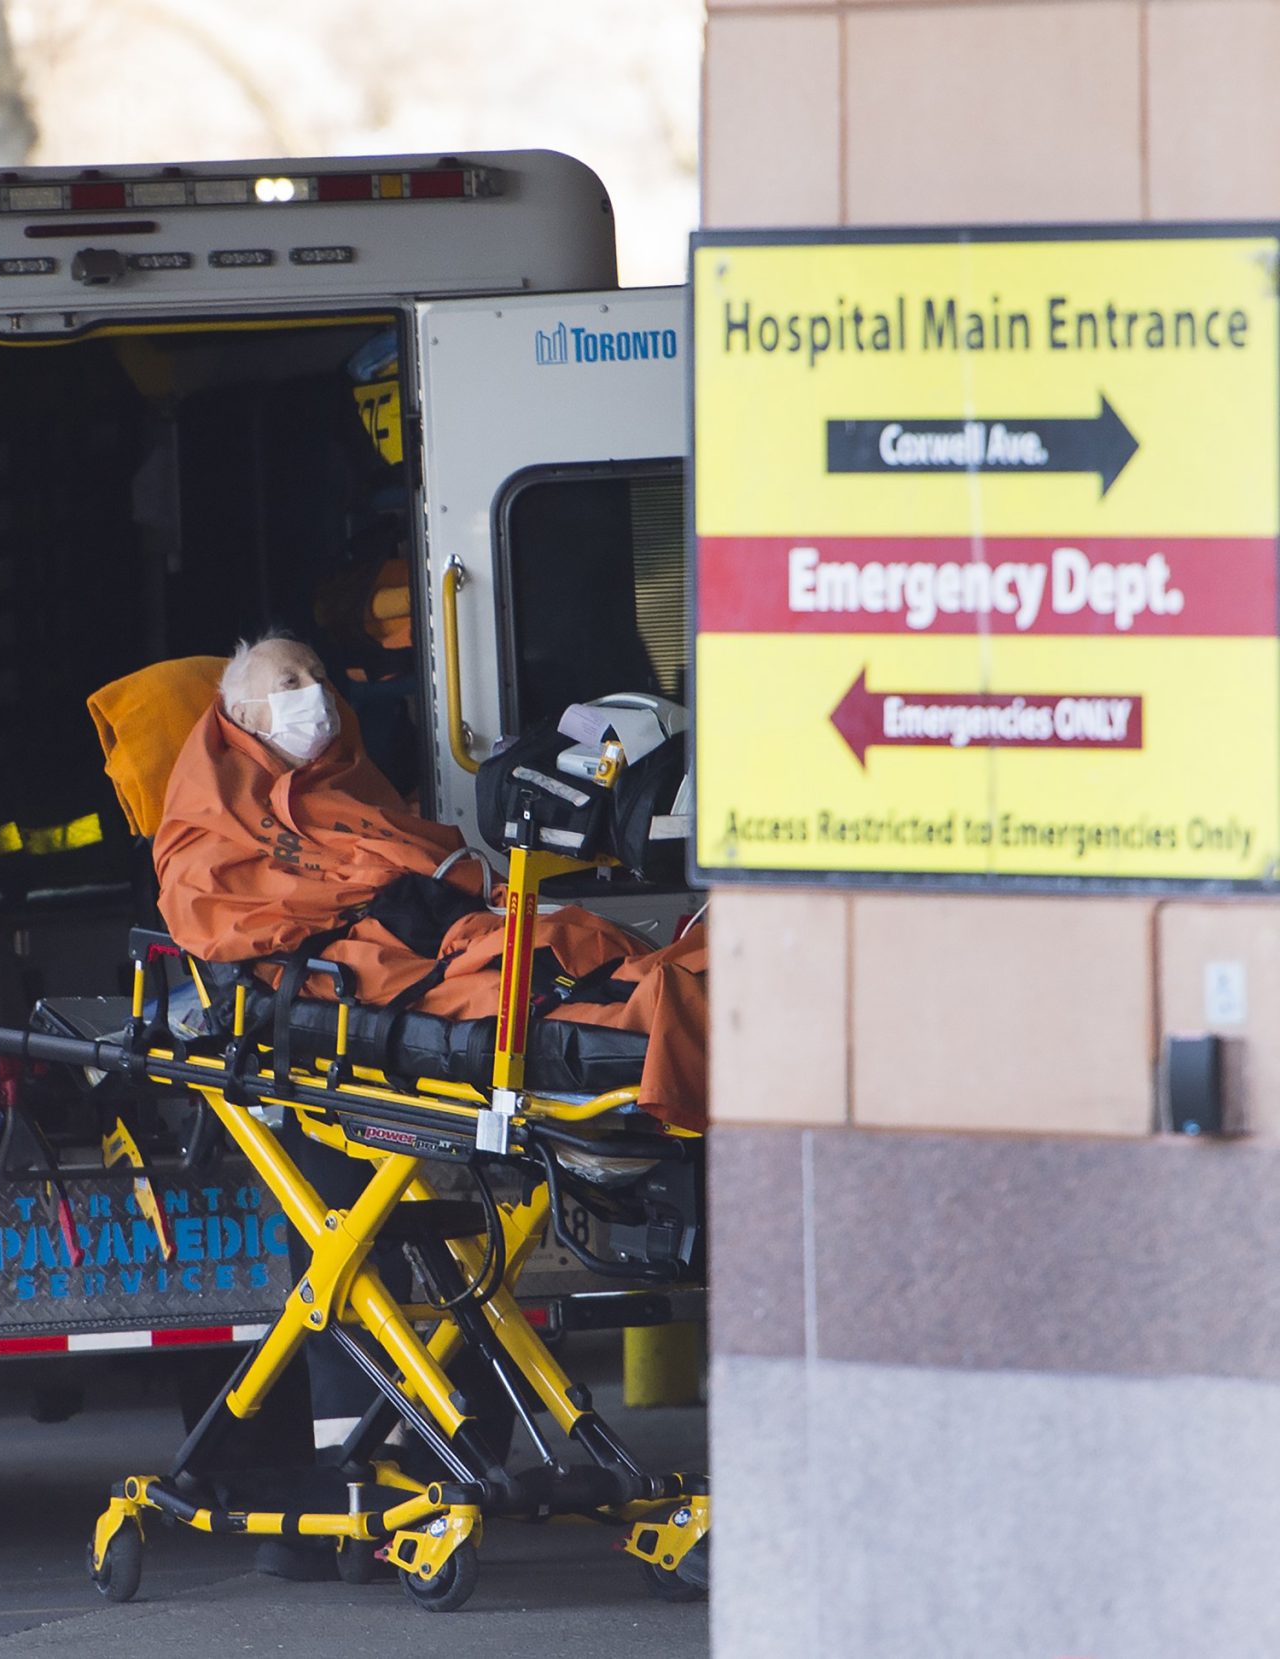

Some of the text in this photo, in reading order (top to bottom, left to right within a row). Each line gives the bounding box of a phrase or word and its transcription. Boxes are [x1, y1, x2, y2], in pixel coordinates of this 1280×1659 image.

[571, 328, 677, 362] TORONTO
[723, 297, 1250, 367] Hospital Main Entrance
[879, 424, 1049, 467] Coxwell Ave.
[787, 547, 1185, 630] Emergency Dept.
[883, 697, 1132, 747] Emergencies ONLY
[725, 812, 1254, 860] Access Restricted to Emergencies Only
[364, 1126, 416, 1144] power
[15, 1187, 261, 1222] TRNTO
[15, 1263, 270, 1300] SERVICES
